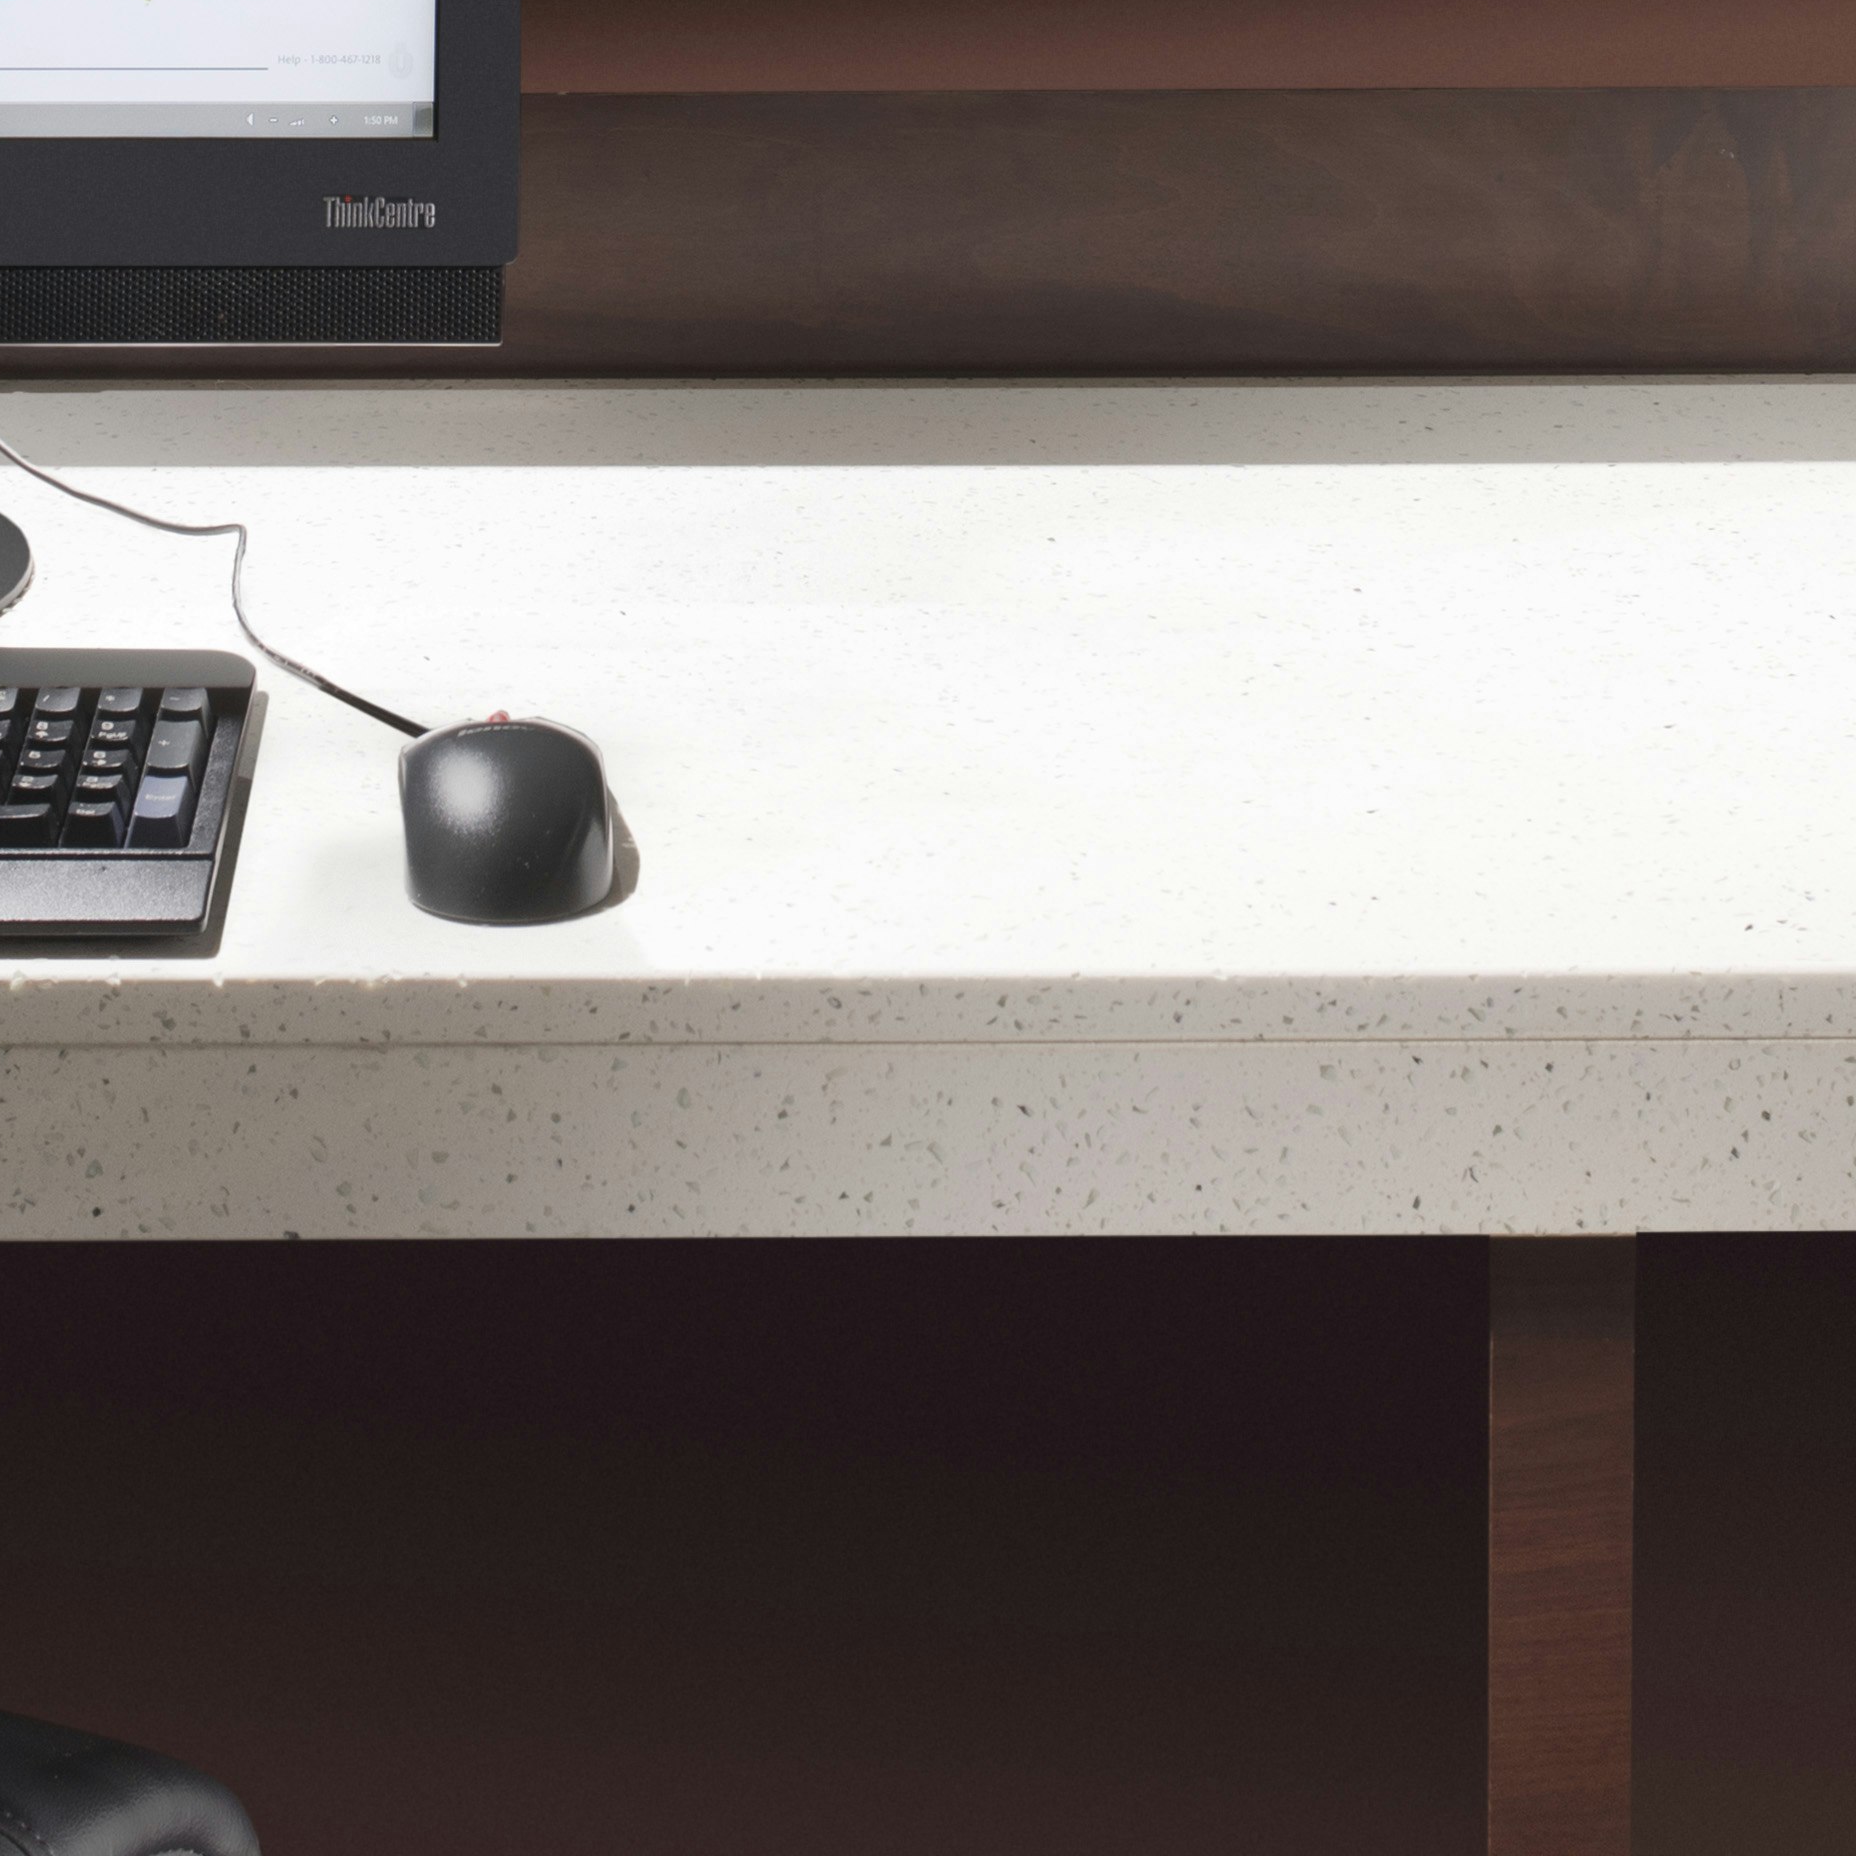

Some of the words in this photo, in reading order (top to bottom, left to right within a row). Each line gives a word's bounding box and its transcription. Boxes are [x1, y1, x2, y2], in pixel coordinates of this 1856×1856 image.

[278, 55, 301, 66] Help
[384, 116, 398, 125] PM
[323, 195, 436, 228] ThinkCentre
